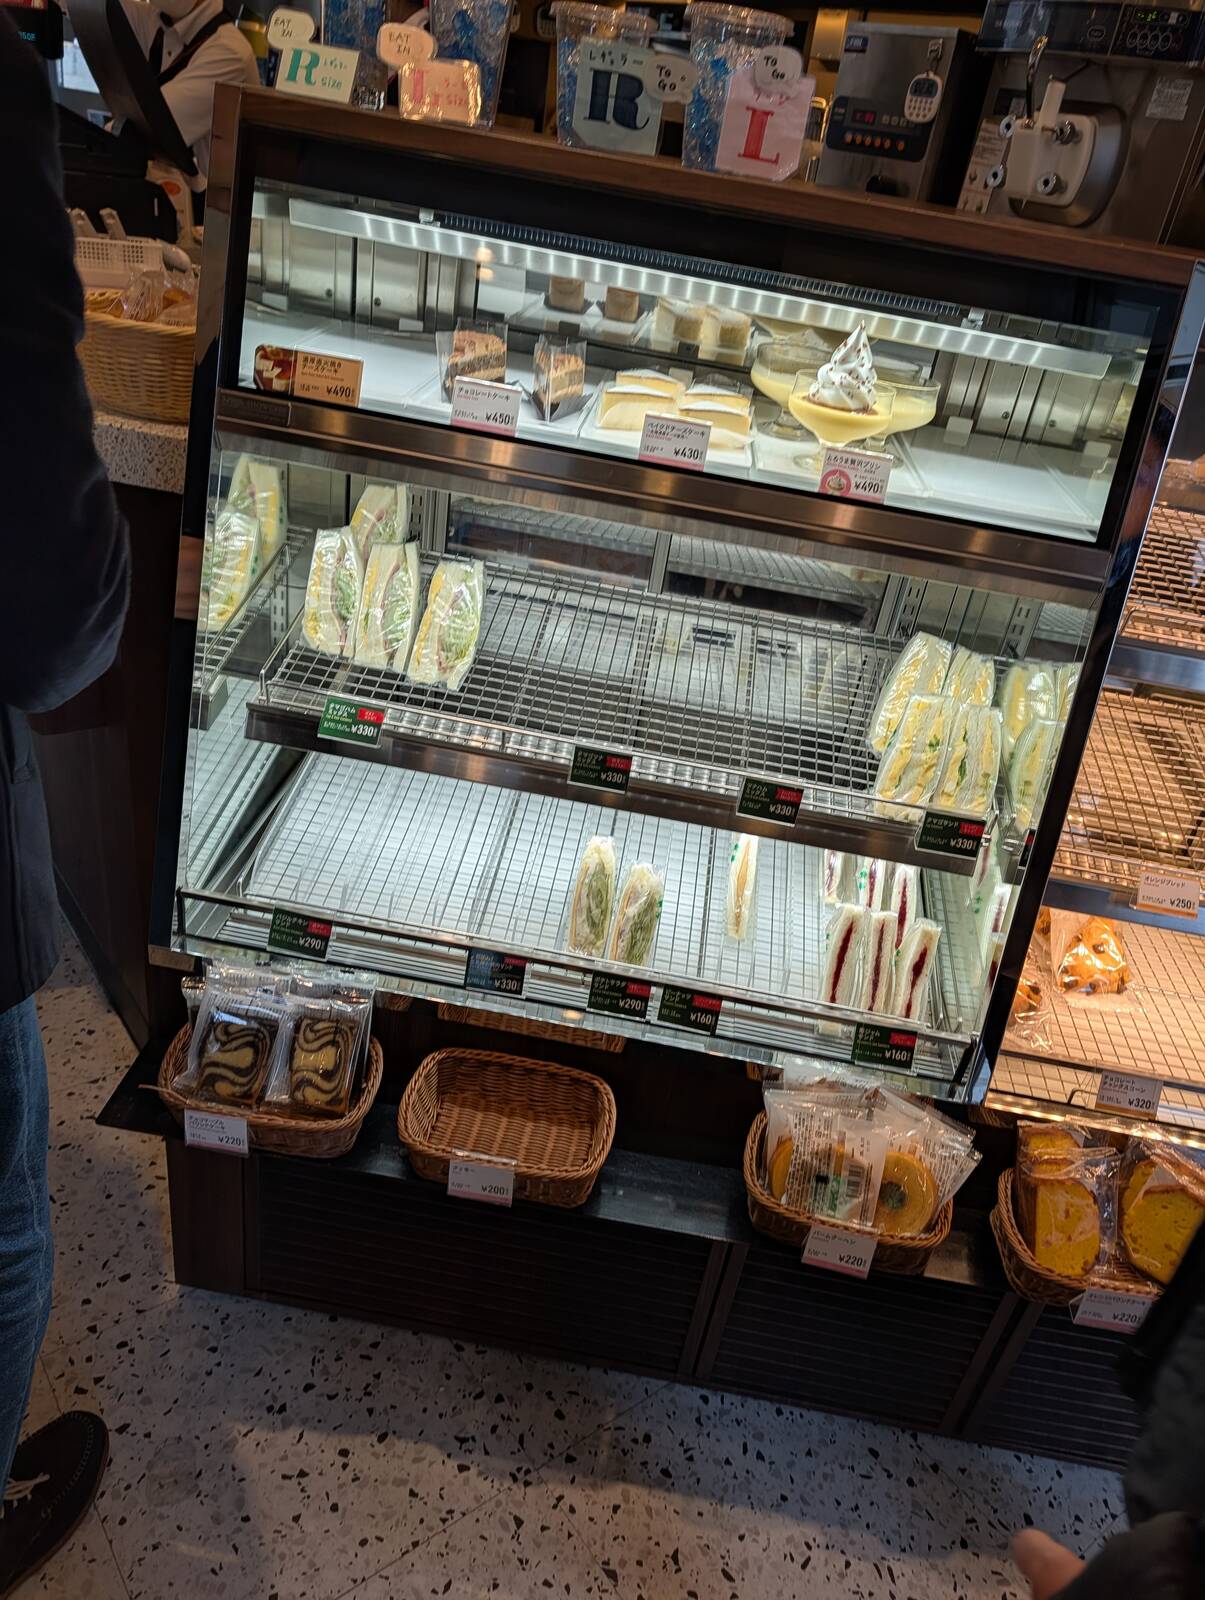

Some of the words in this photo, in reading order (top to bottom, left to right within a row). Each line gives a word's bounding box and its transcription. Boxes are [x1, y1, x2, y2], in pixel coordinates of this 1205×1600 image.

[274, 17, 292, 28] EAT
[281, 29, 293, 38] IN
[388, 31, 411, 43] EAT
[397, 45, 411, 55] IN
[286, 48, 320, 86] R
[583, 67, 651, 131] R
[737, 106, 781, 165] L
[326, 384, 352, 398] ¥490
[485, 412, 511, 426] ¥450
[673, 446, 700, 461] ¥430
[854, 480, 880, 494] ¥490
[351, 724, 375, 737] ¥330
[600, 771, 624, 784] ¥330
[769, 803, 792, 816] ¥330
[949, 838, 974, 850] ¥330
[1169, 897, 1193, 910] ¥250
[299, 936, 322, 950] ¥290
[494, 978, 518, 991] ¥330
[618, 998, 642, 1011] ¥290
[690, 1011, 712, 1025] ¥160
[884, 1049, 908, 1062] ¥160
[1127, 1097, 1152, 1110] ¥320
[217, 1135, 242, 1147] ¥220
[481, 1184, 506, 1196] ¥200
[838, 1254, 863, 1268] ¥220
[1111, 1312, 1138, 1324] ¥220
